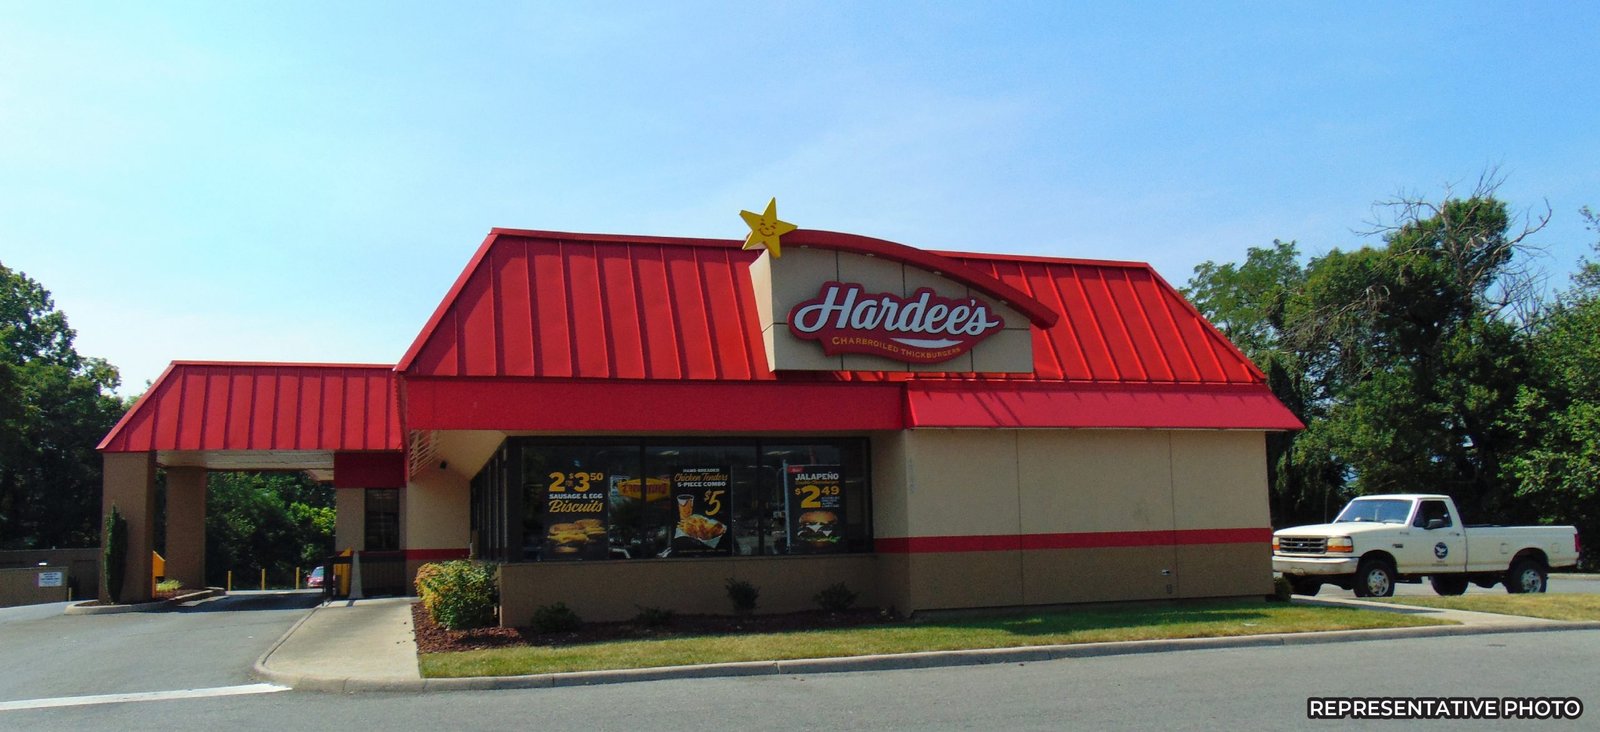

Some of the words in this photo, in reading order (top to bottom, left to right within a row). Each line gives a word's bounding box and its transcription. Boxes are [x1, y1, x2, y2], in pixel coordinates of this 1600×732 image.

[794, 286, 999, 336] Hardee's
[832, 336, 899, 353] CHARBROILED
[901, 347, 961, 360] THICKBURGERS
[548, 471, 566, 492] 2
[795, 471, 839, 481] JALAPEÑO
[548, 500, 603, 513] Biscuits
